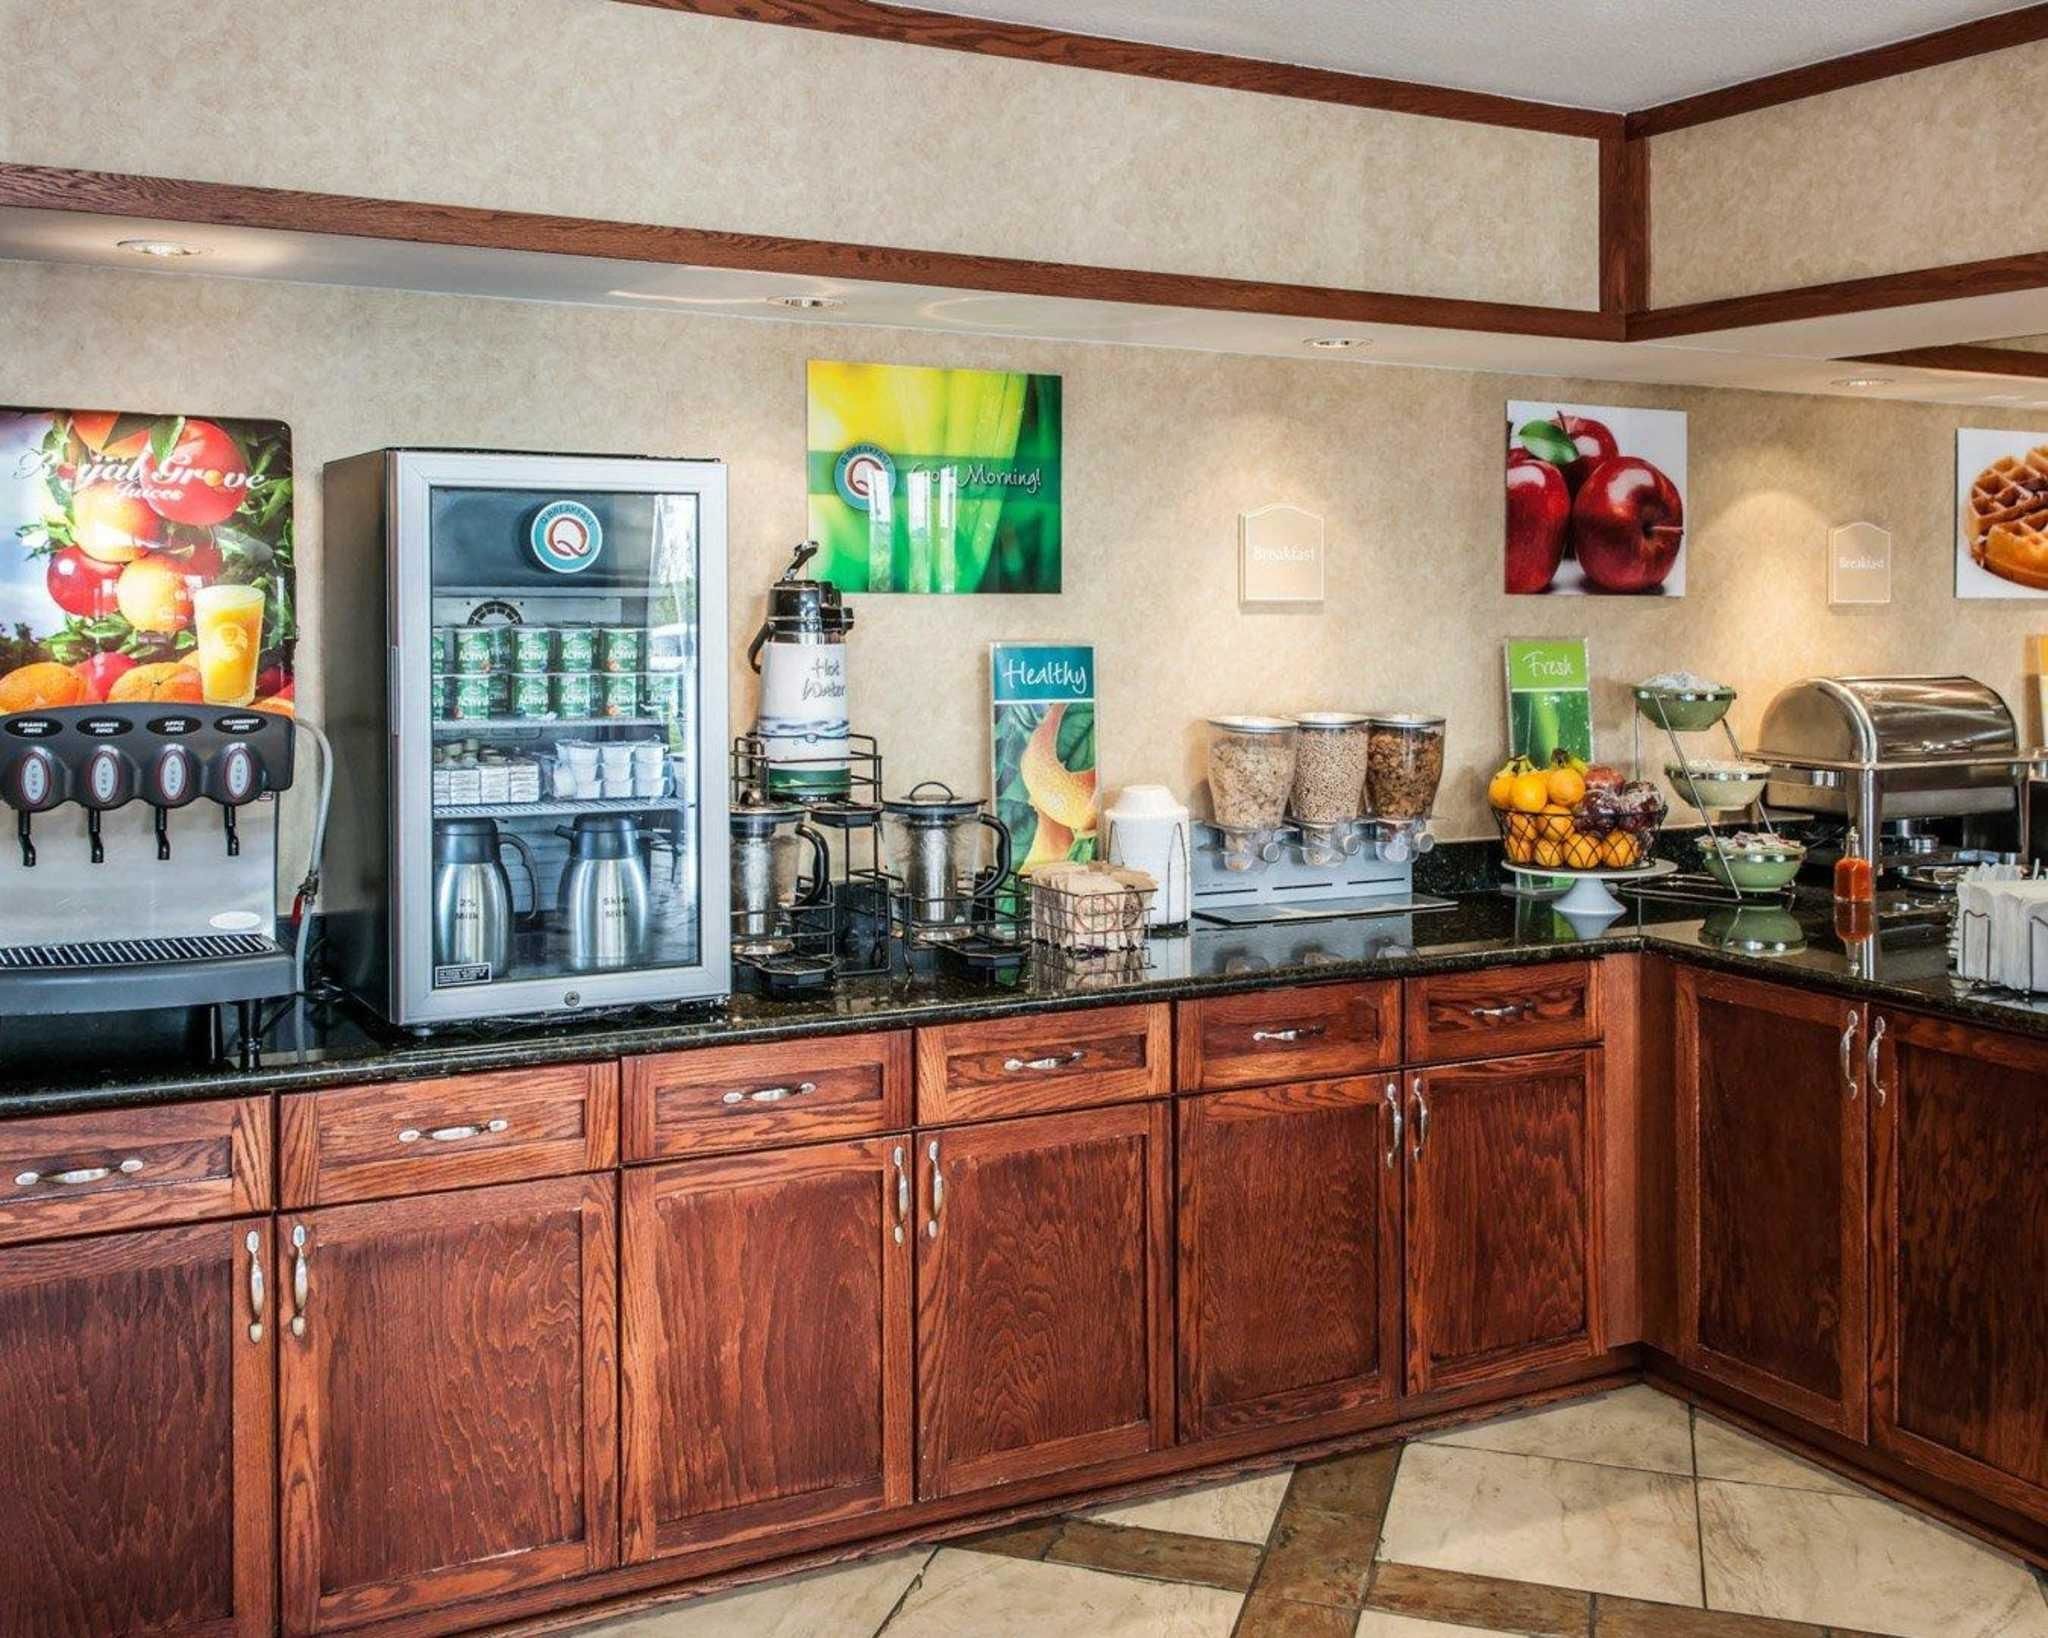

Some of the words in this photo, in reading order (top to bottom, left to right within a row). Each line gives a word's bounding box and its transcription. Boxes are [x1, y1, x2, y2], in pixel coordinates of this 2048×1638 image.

[152, 455, 266, 489] Grove
[957, 463, 1042, 494] Morning!
[1253, 544, 1315, 562] Breakfast
[1839, 554, 1884, 569] Breakfast
[1003, 658, 1087, 694] Healthy
[1521, 651, 1573, 677] Fresh
